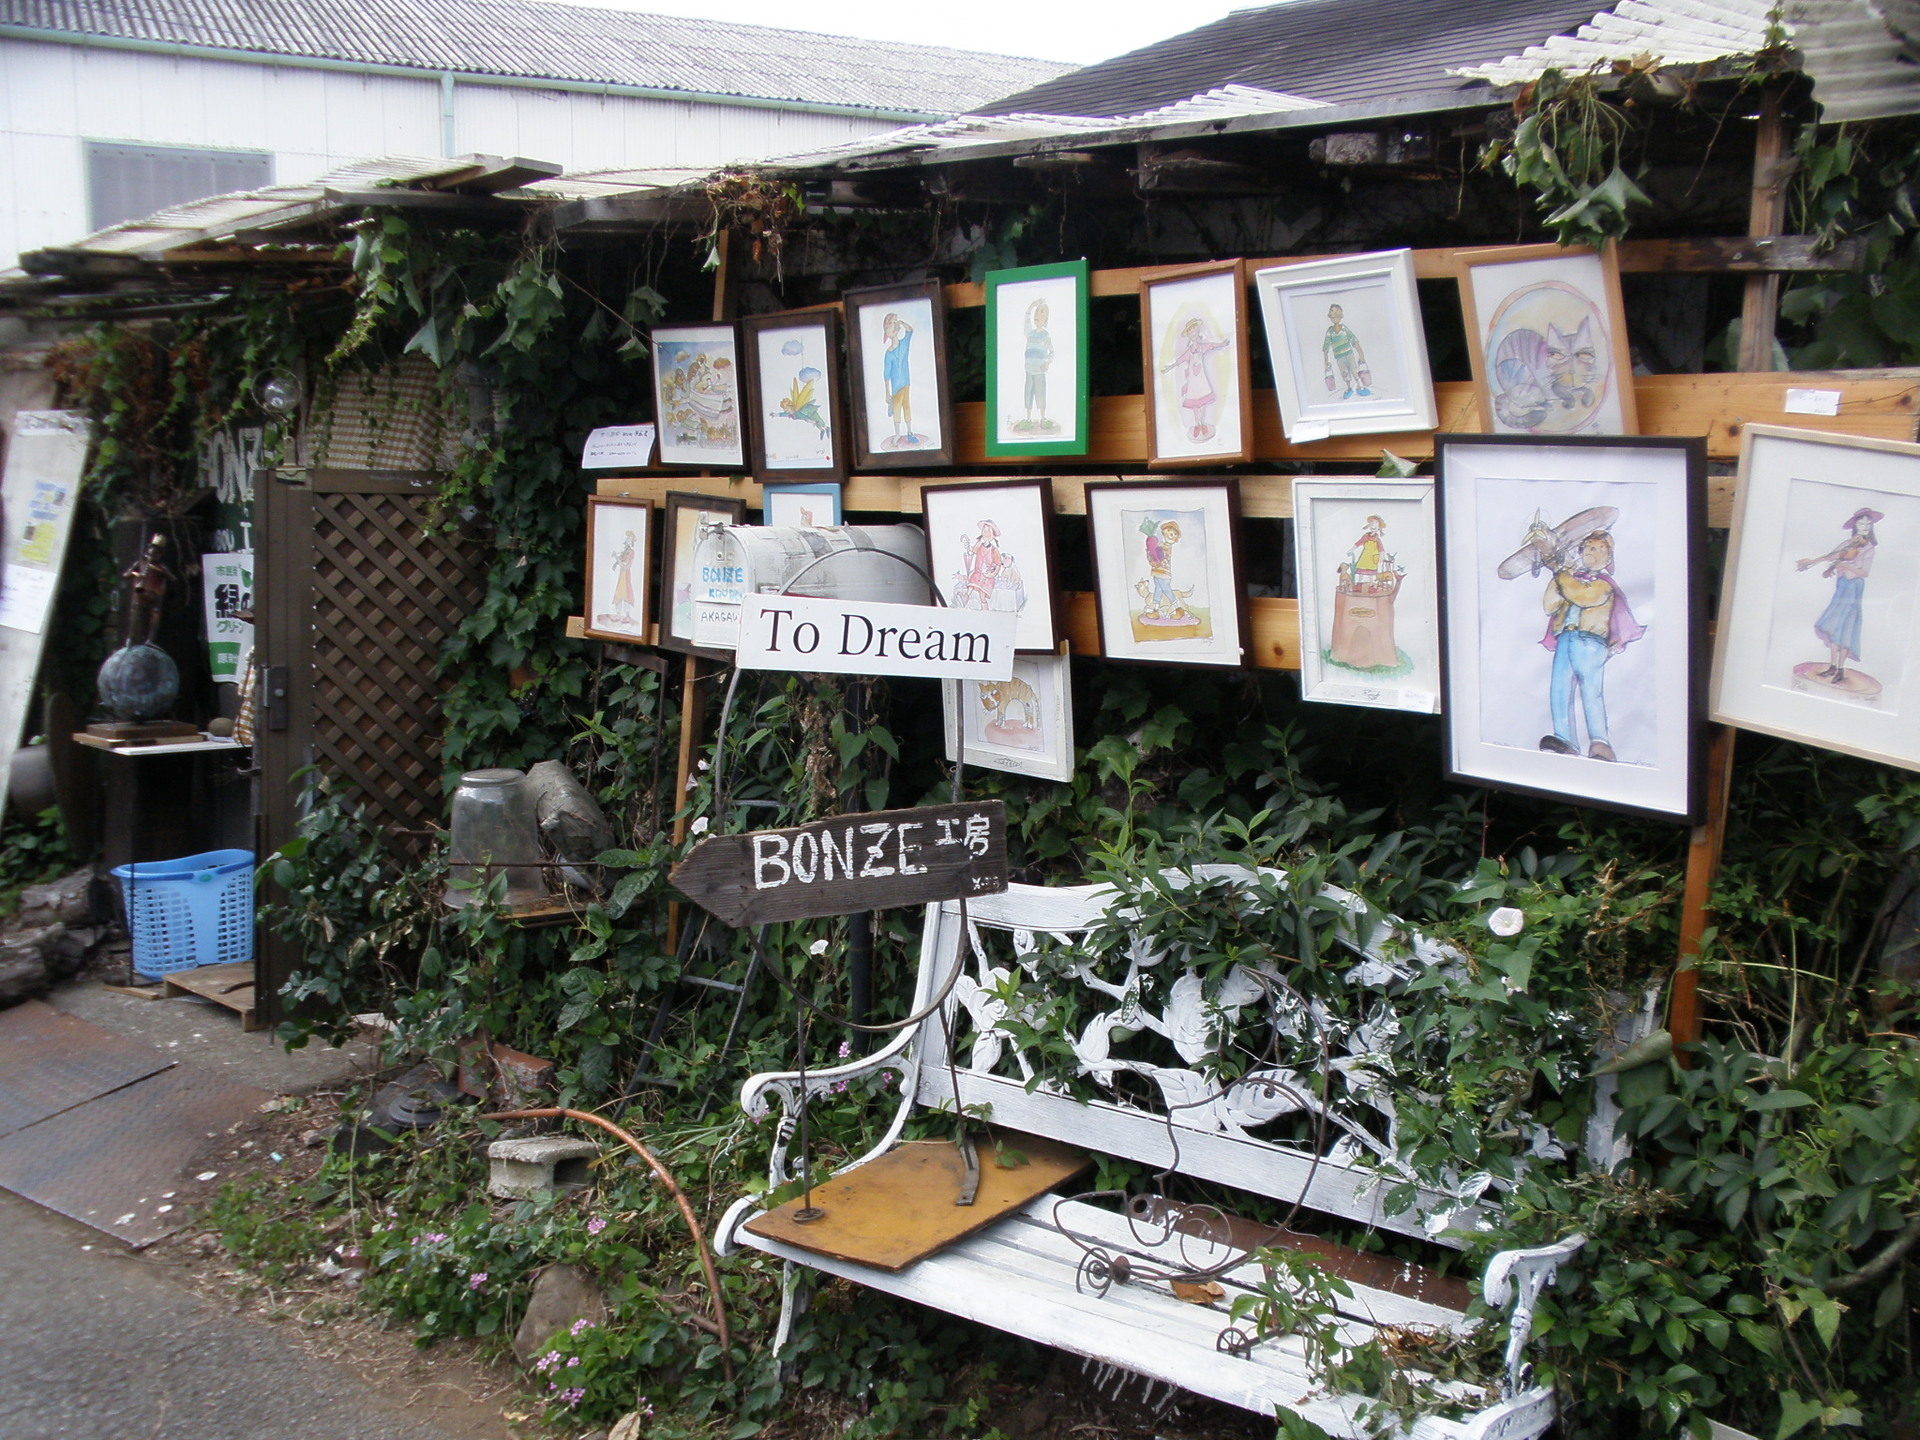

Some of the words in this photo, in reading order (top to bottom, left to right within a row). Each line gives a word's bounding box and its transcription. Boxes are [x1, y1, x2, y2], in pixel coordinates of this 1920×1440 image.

[702, 567, 744, 584] BONZE
[760, 609, 820, 654] To
[838, 613, 992, 665] Dream
[753, 822, 927, 890] BONZE
[935, 812, 991, 860] 工房
